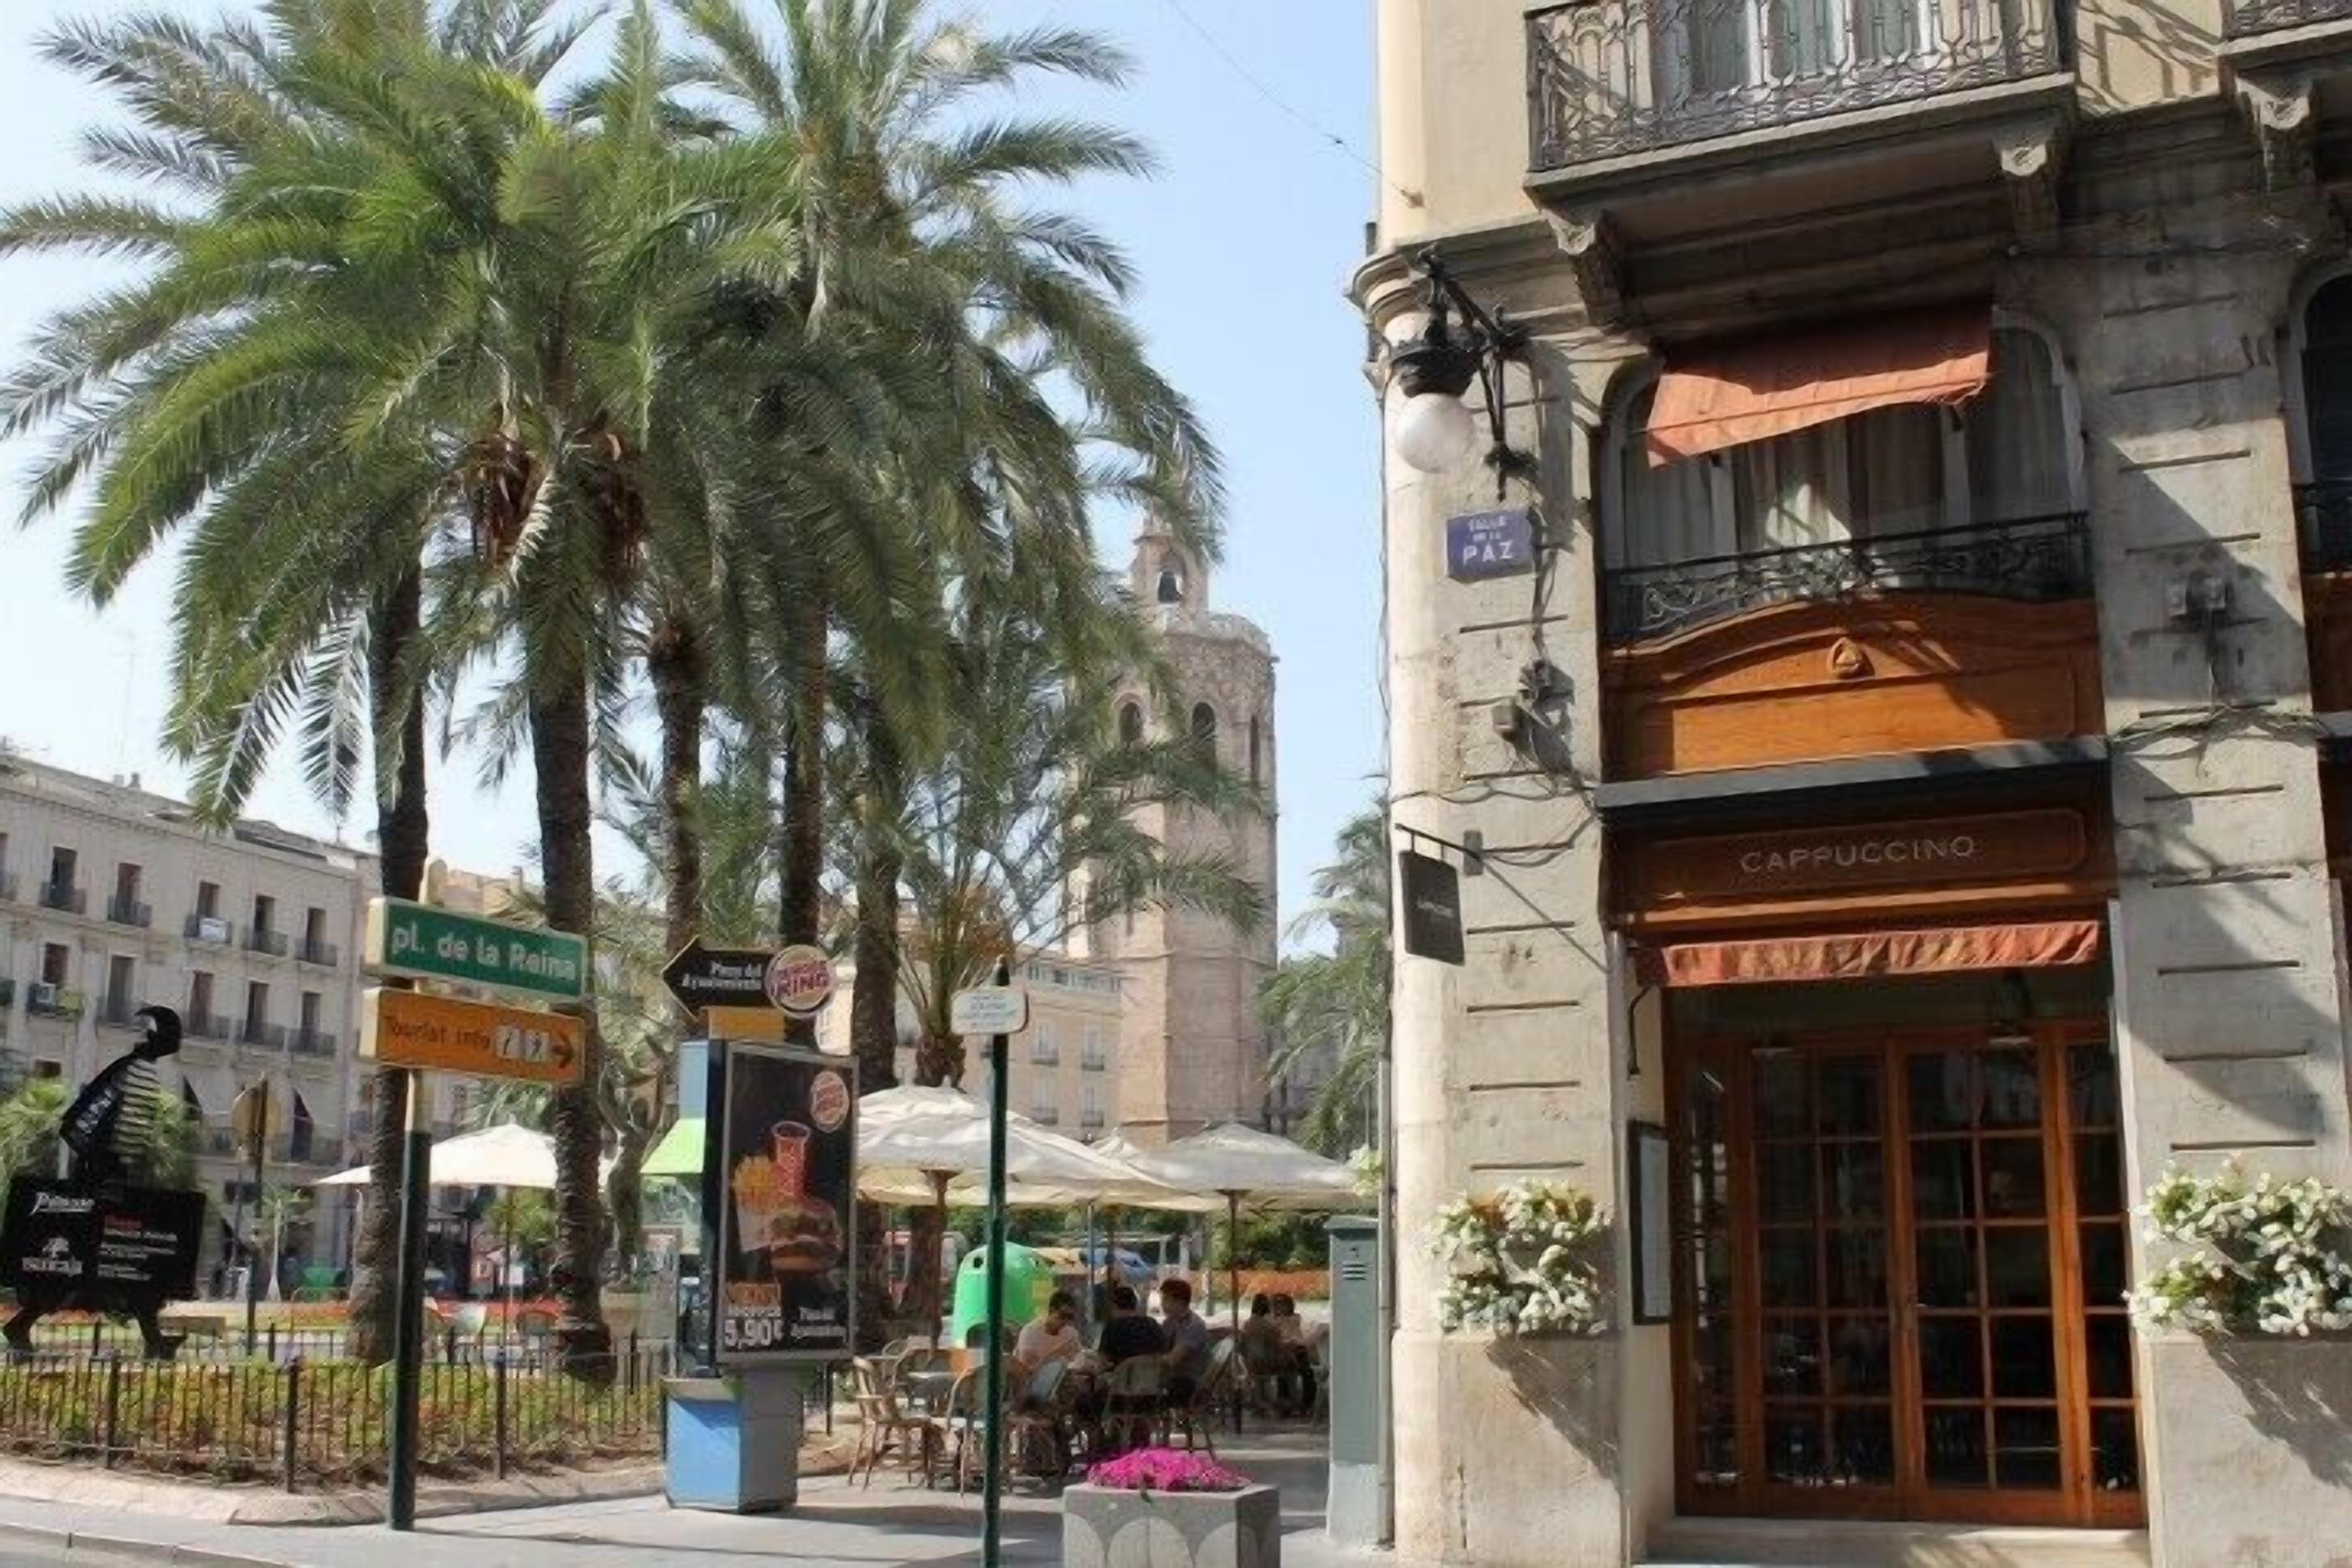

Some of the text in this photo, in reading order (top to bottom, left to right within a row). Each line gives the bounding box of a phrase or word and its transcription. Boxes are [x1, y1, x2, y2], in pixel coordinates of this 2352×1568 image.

[1463, 540, 1514, 565] PAZ
[1740, 835, 1975, 873] CAPPUCCINO
[437, 932, 470, 961] de
[476, 935, 500, 967] la
[509, 942, 577, 981] Reina
[777, 972, 831, 997] KING
